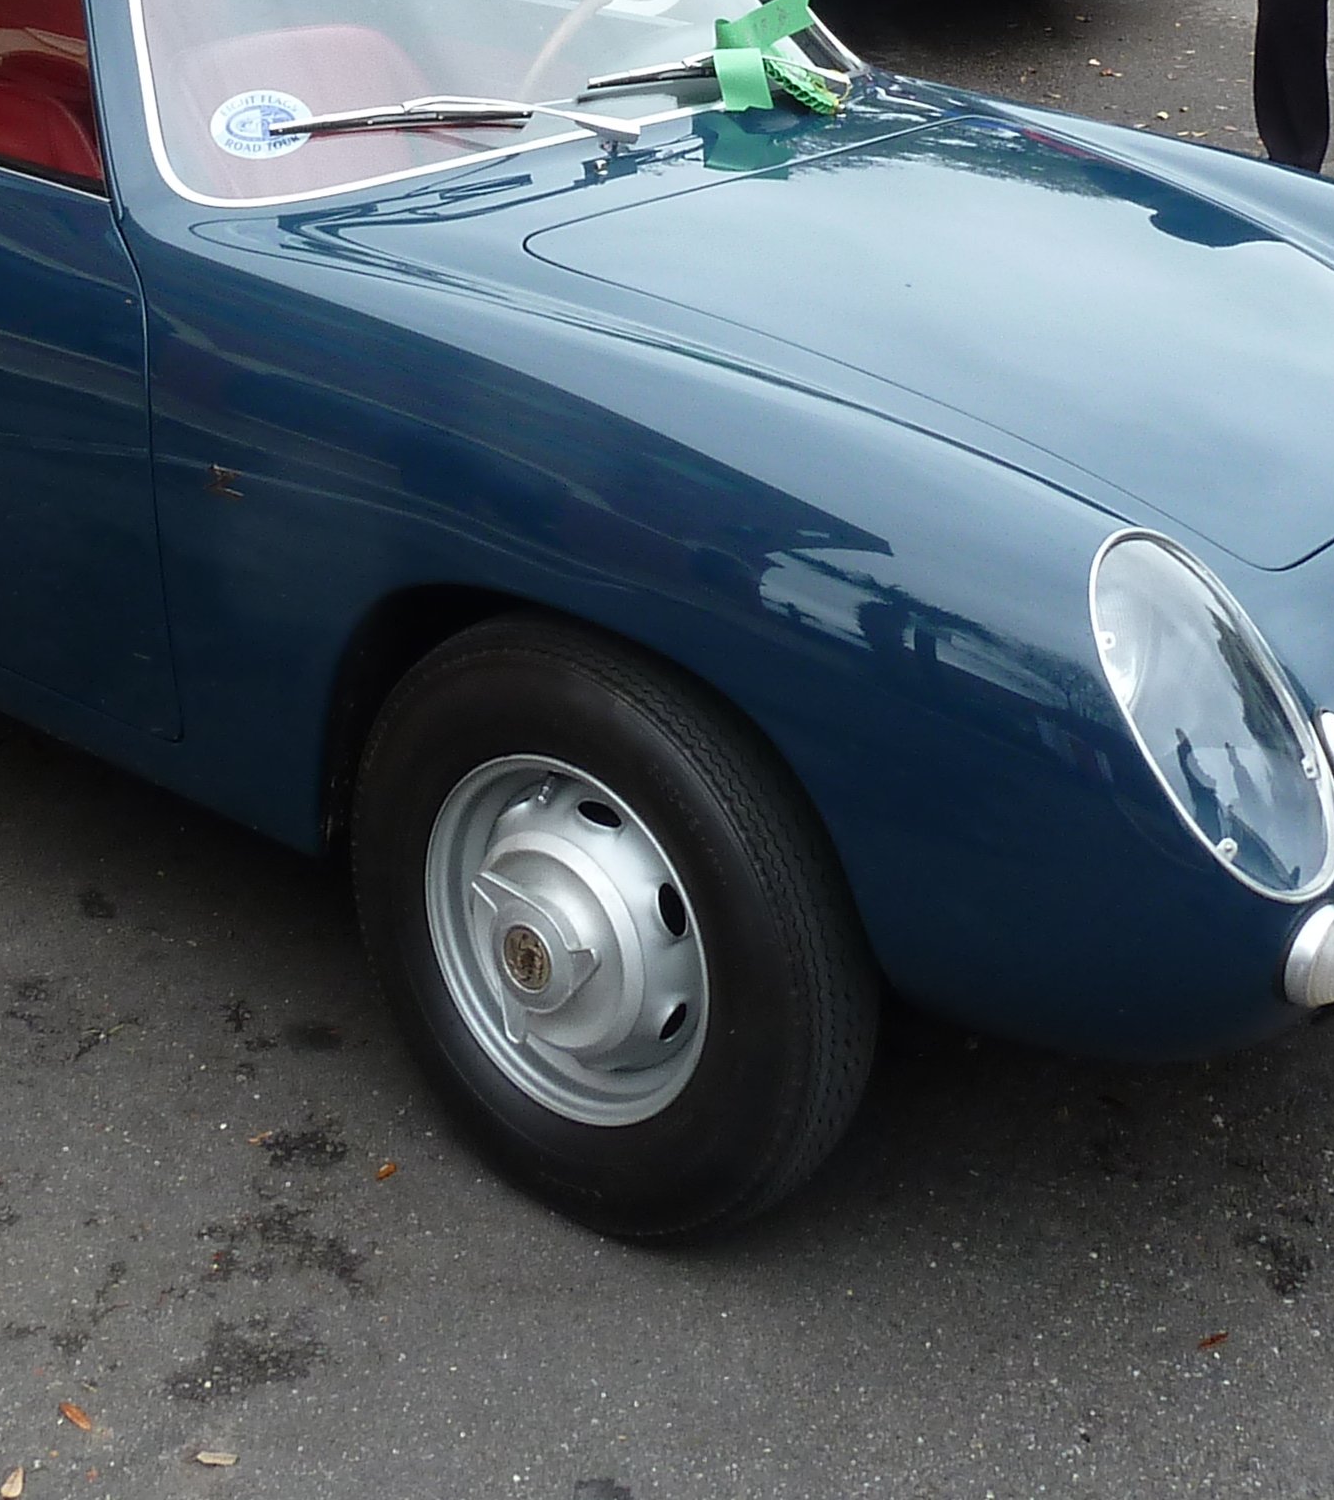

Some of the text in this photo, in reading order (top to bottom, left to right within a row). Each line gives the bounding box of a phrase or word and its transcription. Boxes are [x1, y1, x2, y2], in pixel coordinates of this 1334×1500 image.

[220, 94, 298, 117] EIGHT FLAGS
[225, 134, 301, 153] ROAD TOUR
